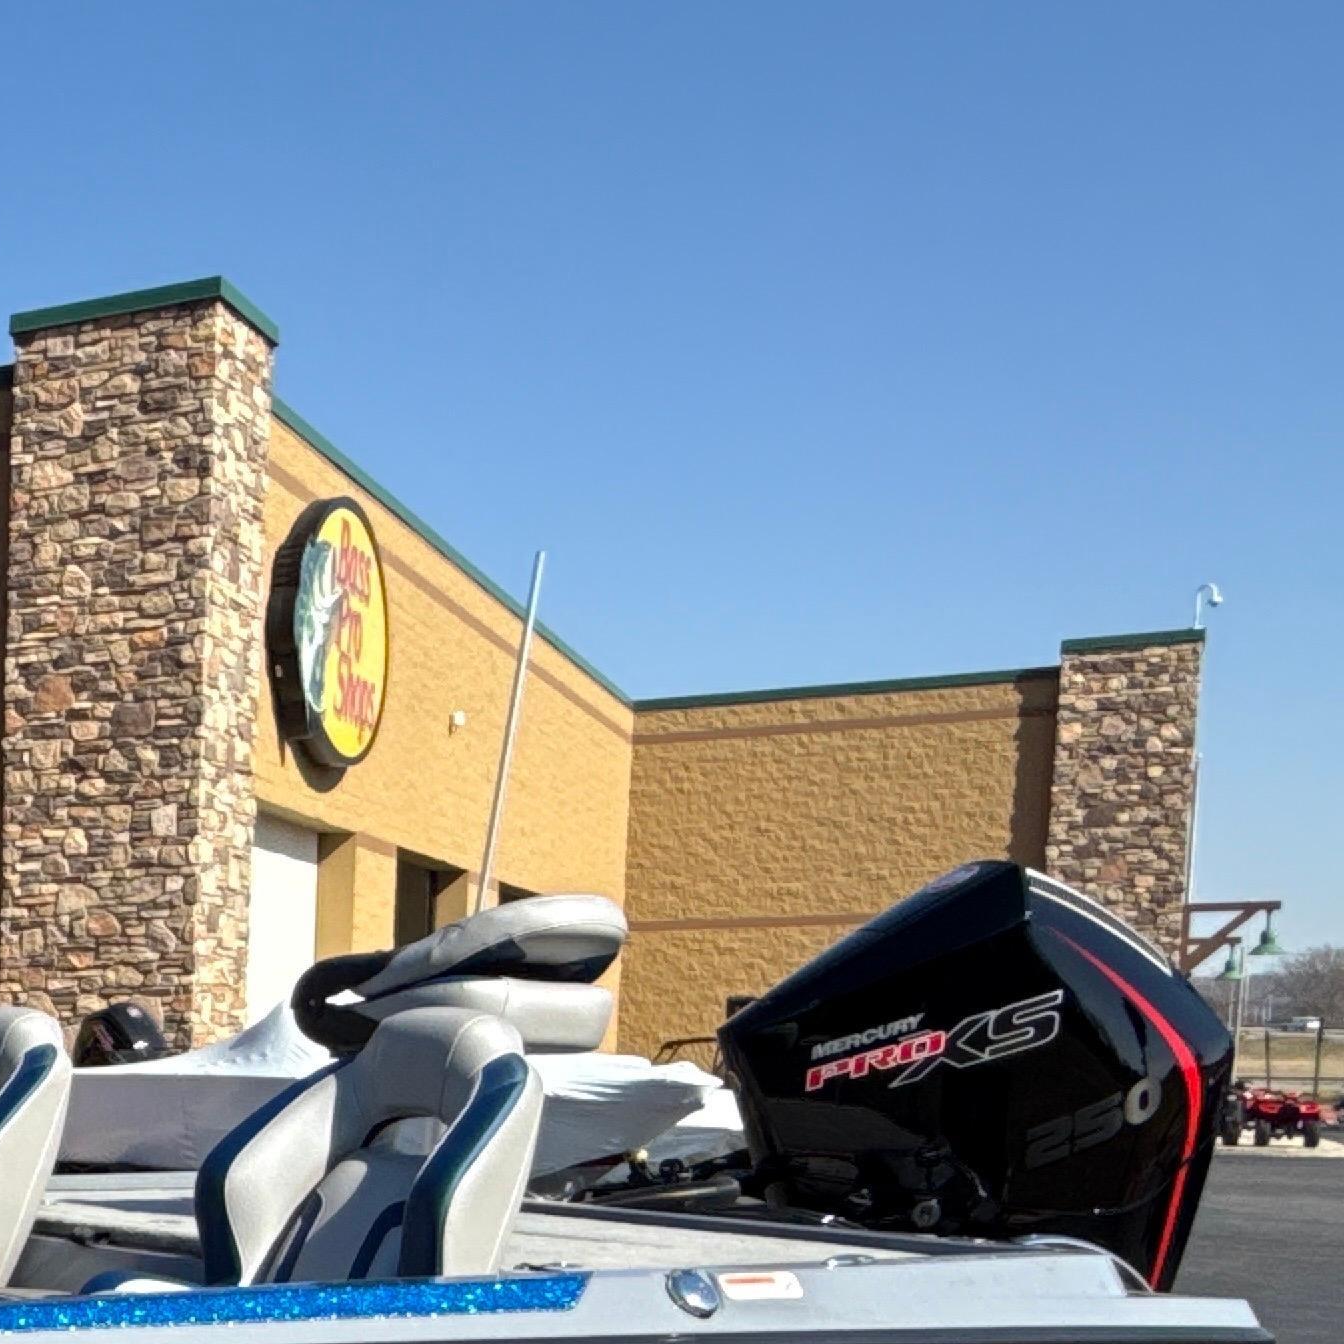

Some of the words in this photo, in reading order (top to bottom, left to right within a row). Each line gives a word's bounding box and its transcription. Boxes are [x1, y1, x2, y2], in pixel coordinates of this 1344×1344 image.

[335, 517, 372, 608] Bass
[335, 588, 363, 664] Pro
[332, 652, 377, 747] Shops
[805, 1030, 947, 1092] PRO
[810, 1012, 925, 1060] MERCURY
[1023, 1074, 1162, 1171] 250
